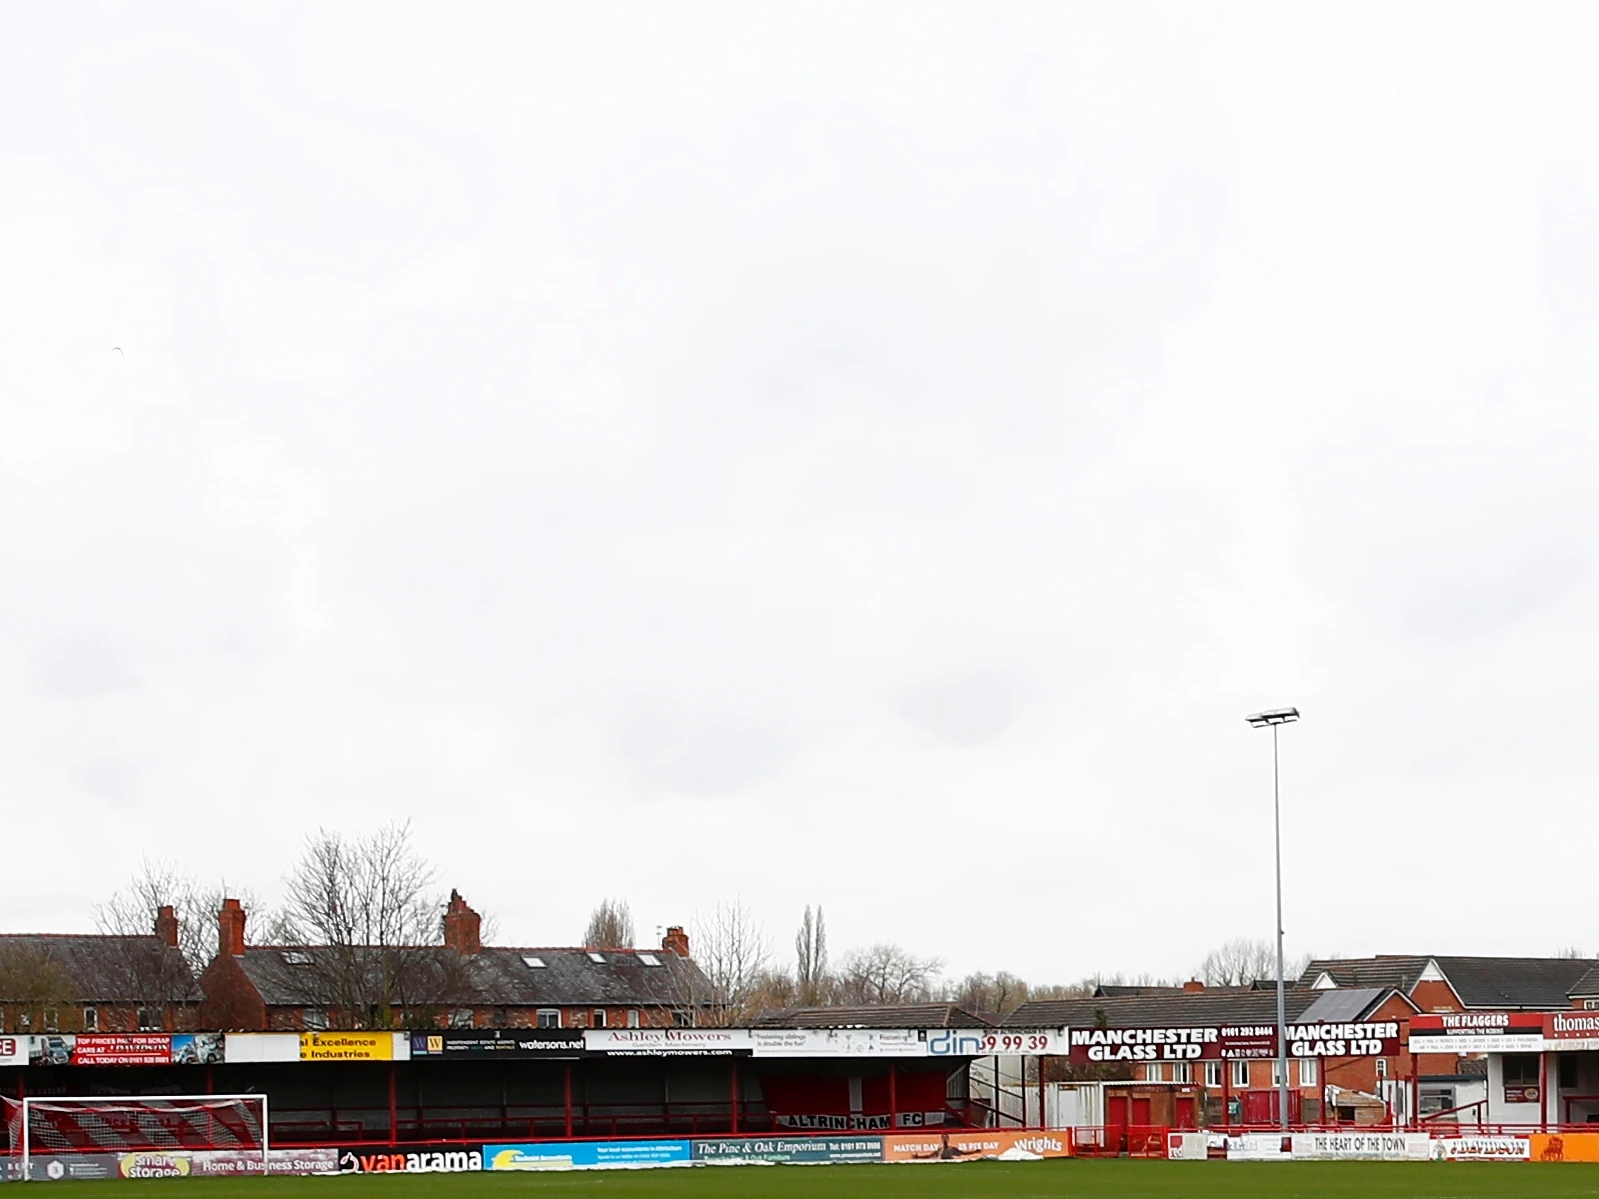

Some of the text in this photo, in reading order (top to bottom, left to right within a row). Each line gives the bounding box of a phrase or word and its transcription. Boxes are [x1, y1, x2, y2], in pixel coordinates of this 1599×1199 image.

[1442, 1015, 1509, 1027] THE FLAGGERS
[608, 1031, 732, 1044] Ashley Mowers
[1071, 1027, 1218, 1046] MANCHESTER
[1221, 1027, 1239, 1037] 0161
[312, 1038, 377, 1047] Excellence
[519, 1040, 584, 1049] watersons.net
[1002, 1035, 1048, 1050] 99 39
[1291, 1039, 1383, 1057] GLASS LTD
[311, 1050, 371, 1058] Industries
[607, 1049, 733, 1057] www.ashleymowers.com
[1088, 1043, 1202, 1061] GLASS LTD
[788, 1114, 922, 1130] ALTRINCHAM FC
[698, 1140, 826, 1154] The Pine & Oak Emporium
[893, 1143, 940, 1152] MATCH DAY
[983, 1141, 1000, 1149] DAY
[1014, 1136, 1063, 1152] Wrights
[1314, 1137, 1406, 1150] THE HEART OF THE TOWN
[135, 1154, 174, 1166] smart
[203, 1159, 334, 1171] Home & Busness Storage
[360, 1151, 482, 1172] vanarama
[130, 1165, 181, 1177] storage
